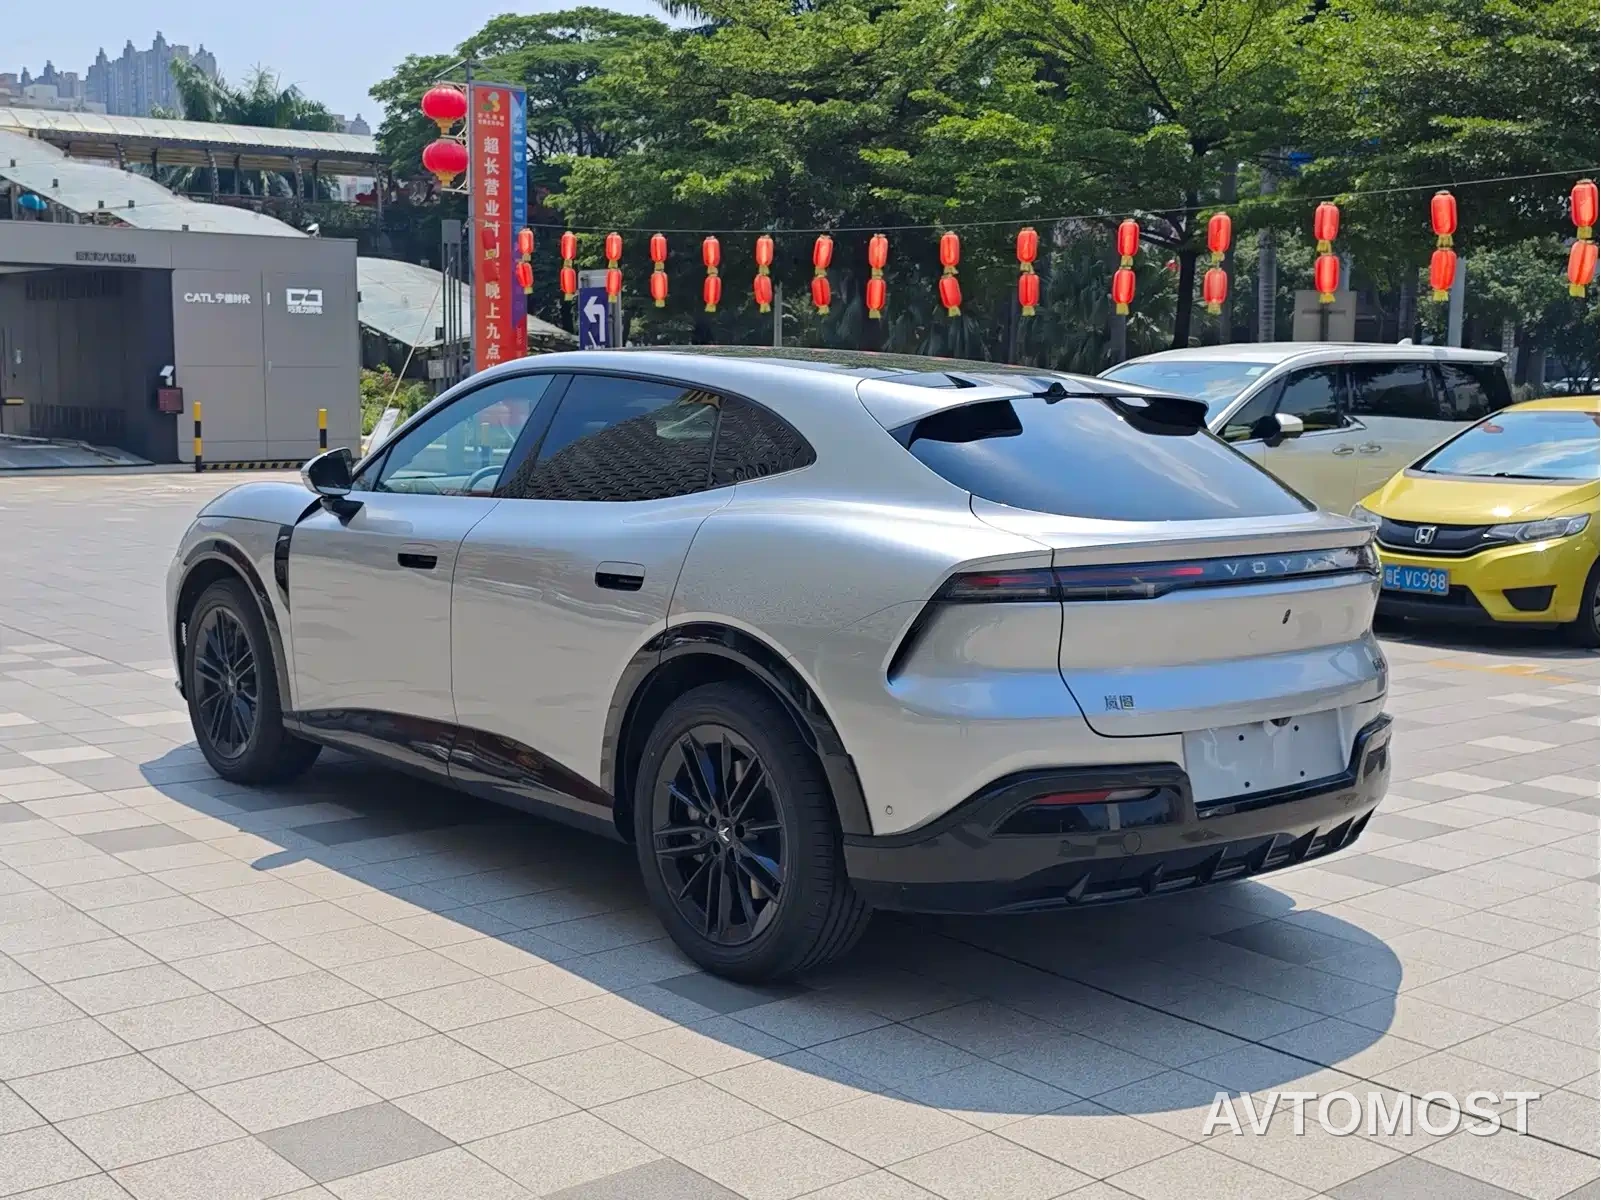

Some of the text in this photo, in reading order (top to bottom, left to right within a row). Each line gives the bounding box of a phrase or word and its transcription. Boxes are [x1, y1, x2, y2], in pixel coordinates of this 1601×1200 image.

[184, 292, 215, 303] CATL
[1224, 555, 1336, 575] VOYAH
[1405, 570, 1446, 590] VC988
